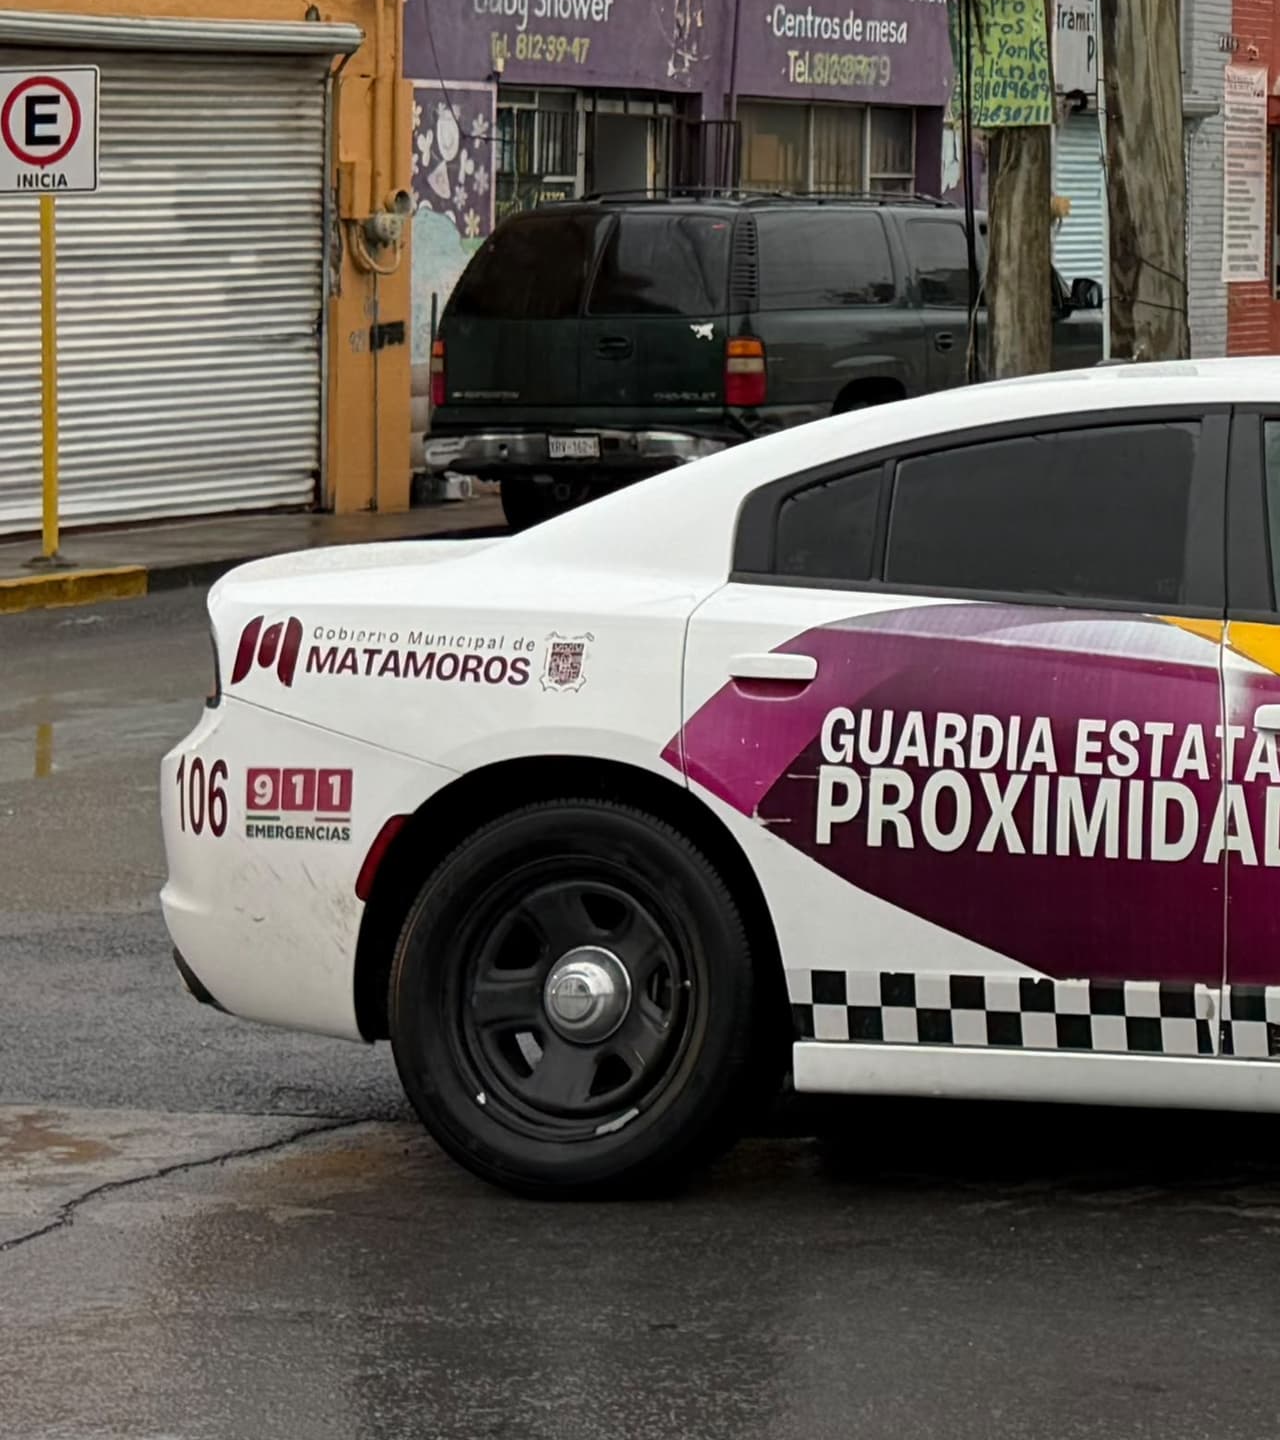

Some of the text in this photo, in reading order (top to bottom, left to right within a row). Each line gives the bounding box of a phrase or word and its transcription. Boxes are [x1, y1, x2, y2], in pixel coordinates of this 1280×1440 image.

[772, 3, 908, 45] Centros de mesa
[25, 94, 61, 146] E
[17, 172, 68, 188] INICIA
[312, 625, 537, 653] Gobierno Municipal de
[304, 645, 532, 686] MATAMOROS
[819, 706, 1055, 776] GUARDIA
[175, 753, 229, 838] 106
[251, 773, 343, 807] 911
[245, 822, 351, 842] EMERGENCIAS
